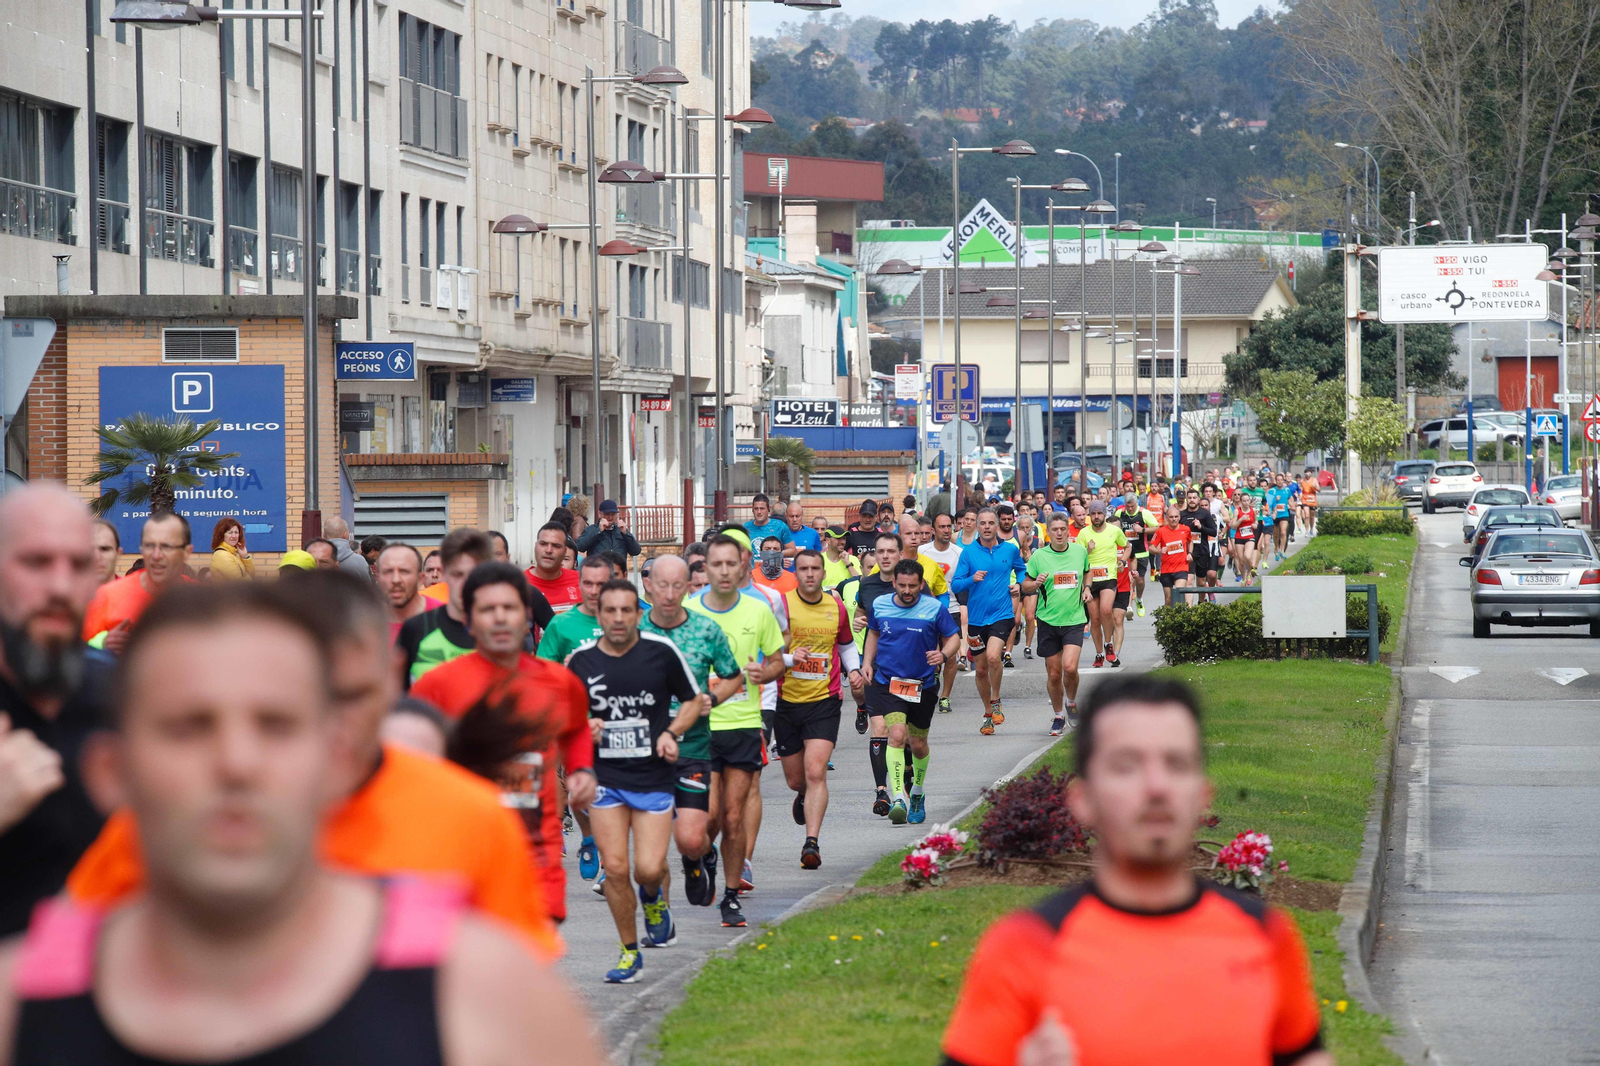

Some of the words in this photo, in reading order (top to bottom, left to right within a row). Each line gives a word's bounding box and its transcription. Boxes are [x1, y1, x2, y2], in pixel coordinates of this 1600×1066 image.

[1462, 255, 1488, 263] VIGO
[1468, 267, 1485, 275] TUI
[1492, 280, 1518, 288] N-550
[1472, 300, 1541, 308] PONTEVEDRA
[340, 351, 384, 360] ACCESO
[344, 362, 381, 372] PEÓNS
[943, 371, 968, 400] P
[182, 380, 202, 405] P
[641, 401, 650, 409] 34
[651, 401, 659, 409] 89
[661, 401, 670, 409] 89
[778, 401, 834, 412] HOTEL
[792, 412, 831, 425] Azul
[193, 509, 240, 518] segunda
[1525, 575, 1544, 583] 4334
[1545, 575, 1559, 583] BNG
[799, 661, 819, 673] 436
[899, 684, 910, 695] 77
[608, 731, 636, 750] 1618
